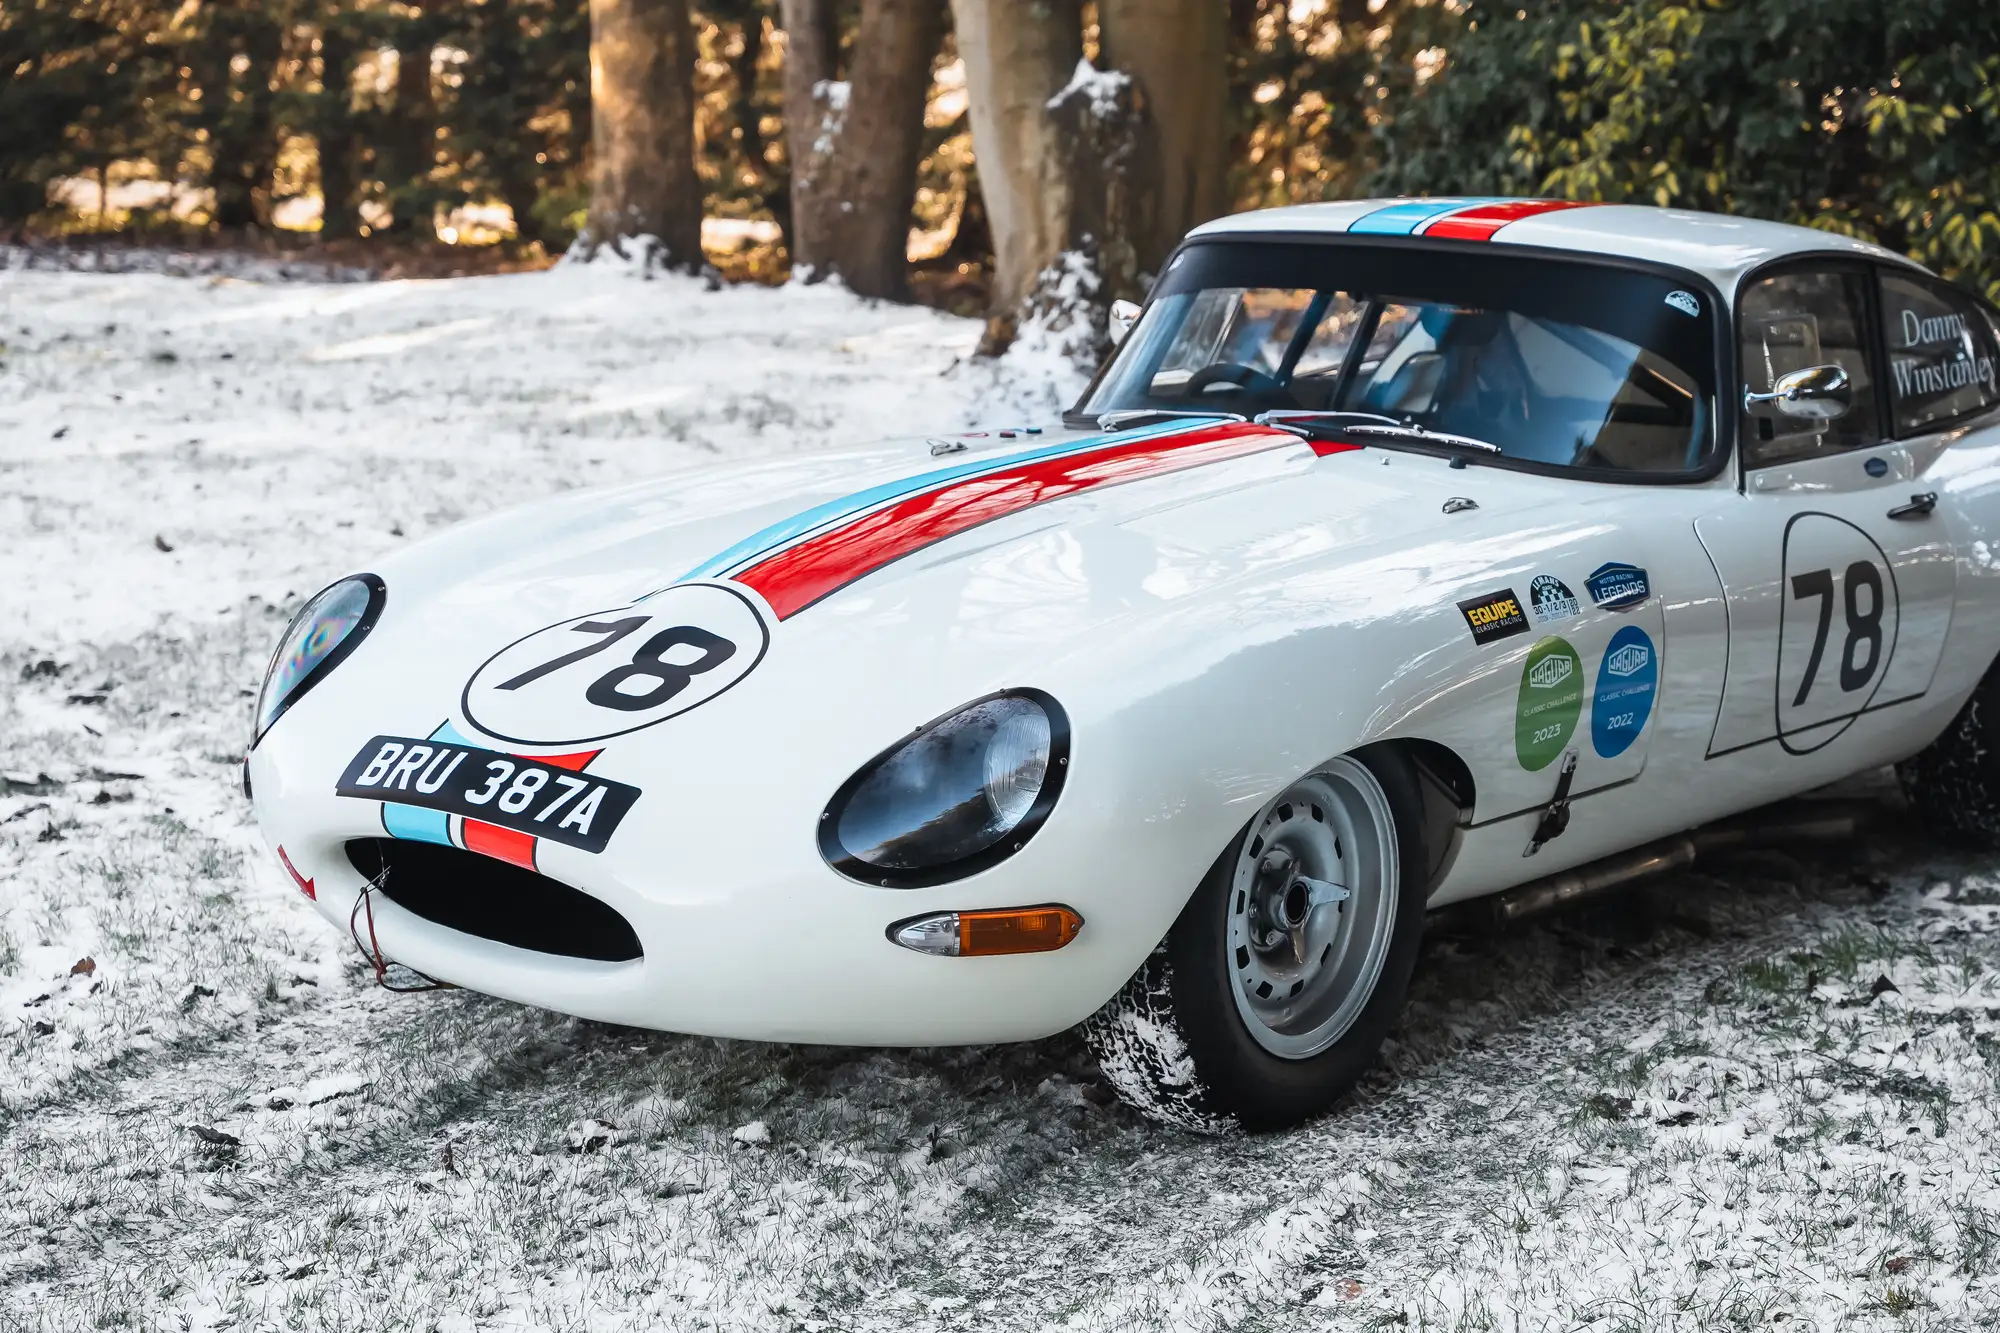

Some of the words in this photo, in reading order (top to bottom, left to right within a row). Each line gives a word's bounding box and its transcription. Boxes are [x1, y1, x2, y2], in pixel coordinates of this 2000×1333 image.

[1901, 309, 1965, 348] Danny
[1594, 580, 1646, 602] LEGENDS
[1598, 575, 1616, 584] MOTOR
[1467, 599, 1520, 626] EQUIPE
[1475, 622, 1500, 633] CLASSIC
[1500, 614, 1523, 626] RACING
[1790, 559, 1884, 708] 78
[493, 614, 737, 711] 78
[1531, 658, 1571, 687] JAGUAR
[1610, 648, 1647, 674] JAGUAR
[1523, 703, 1546, 717] CLASSIC
[1546, 692, 1578, 710] CHALLENGE
[1600, 692, 1621, 703] CLASSIC
[1621, 684, 1651, 698] CHALLENGE
[1532, 723, 1562, 745] 2023
[1607, 712, 1634, 731] 2022
[355, 741, 468, 795] BRU
[464, 758, 610, 837] 387A
